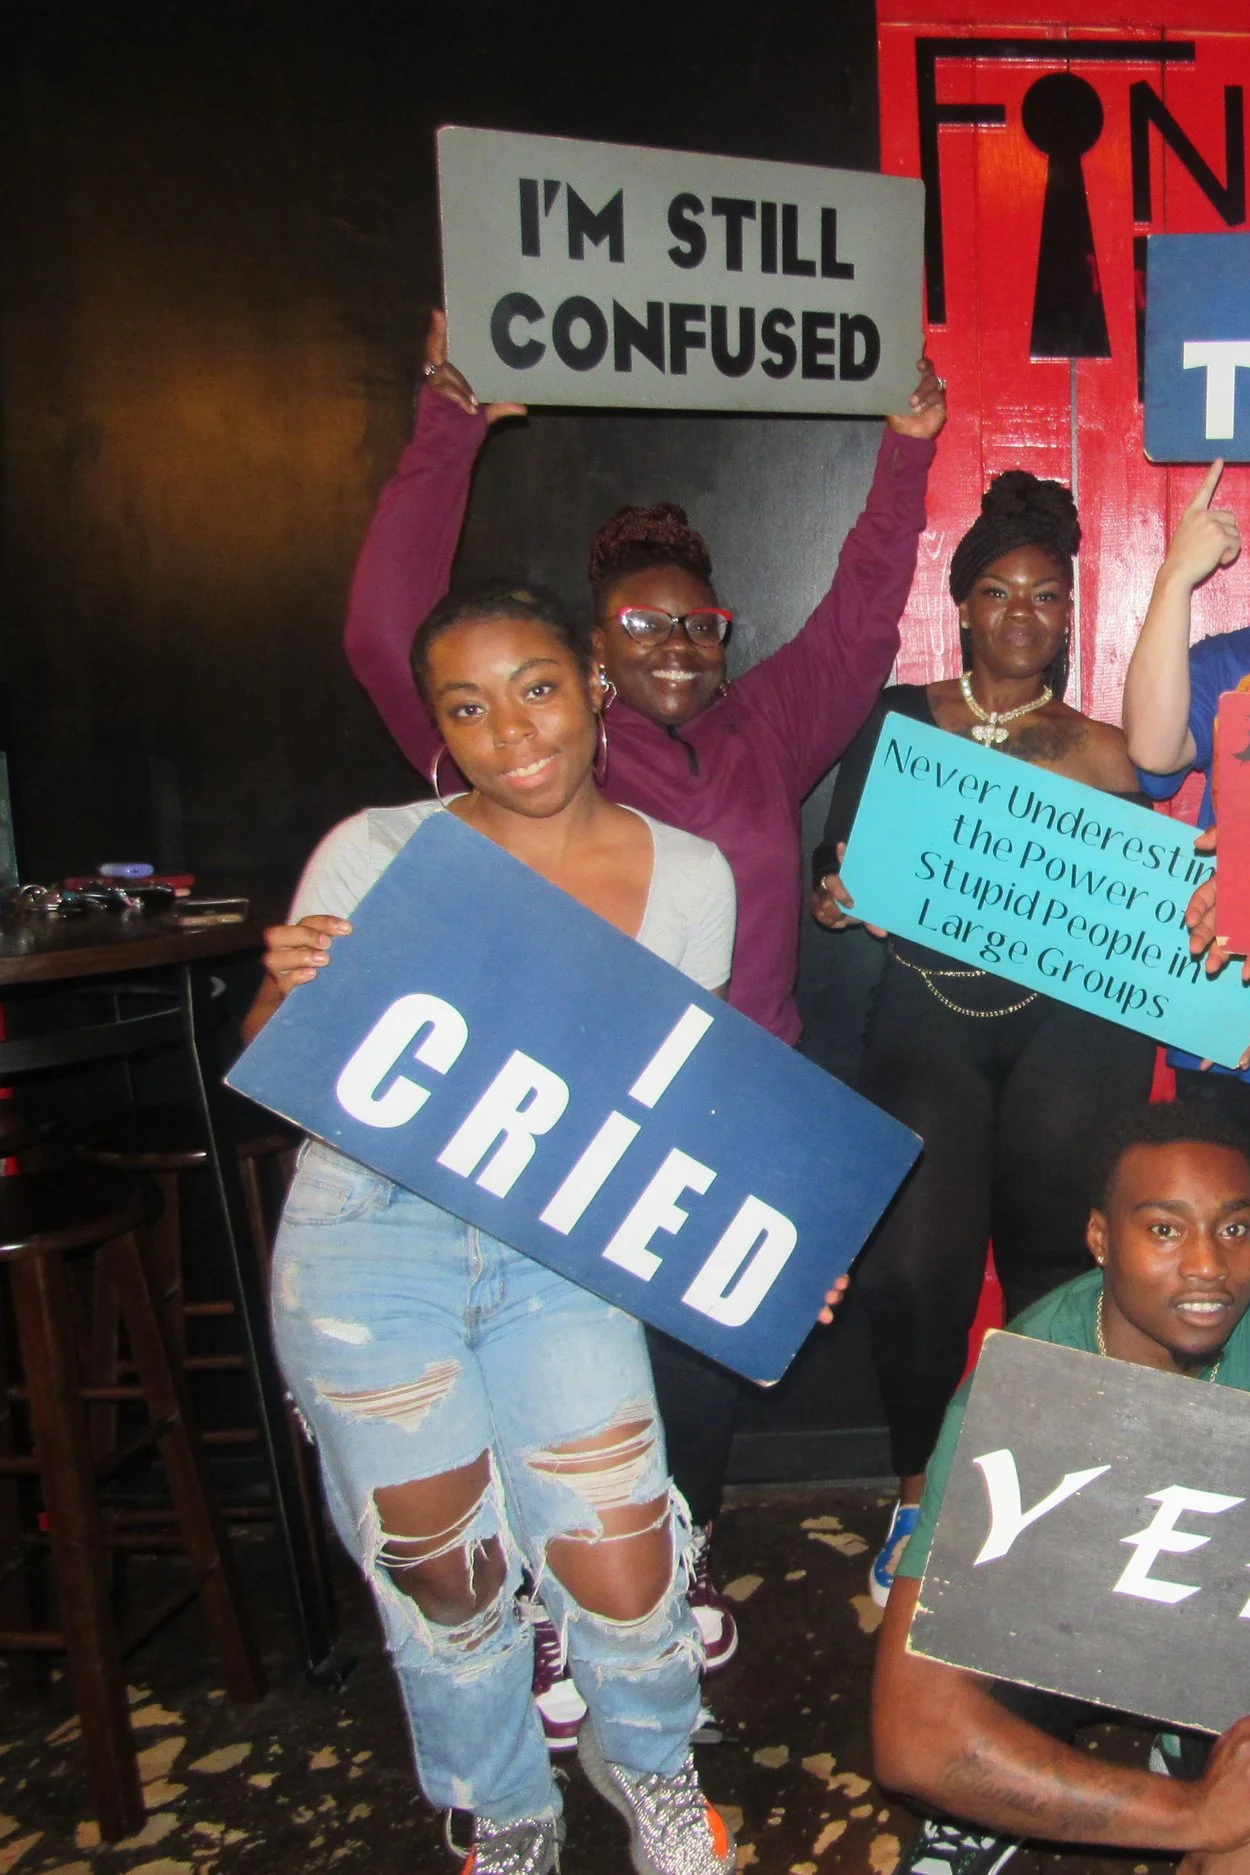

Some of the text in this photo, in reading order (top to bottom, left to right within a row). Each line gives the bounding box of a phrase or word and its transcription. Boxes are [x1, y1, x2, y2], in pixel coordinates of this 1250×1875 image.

[518, 177, 855, 281] I'M STILL
[490, 292, 882, 382] CONFUSED
[883, 738, 1002, 805] Never
[952, 813, 1014, 864] the
[1018, 839, 1150, 911] Power
[913, 850, 1202, 984] Stupid People in
[917, 898, 1170, 1019] Large Groups
[628, 1003, 715, 1109] I
[336, 993, 799, 1328] CRIED
